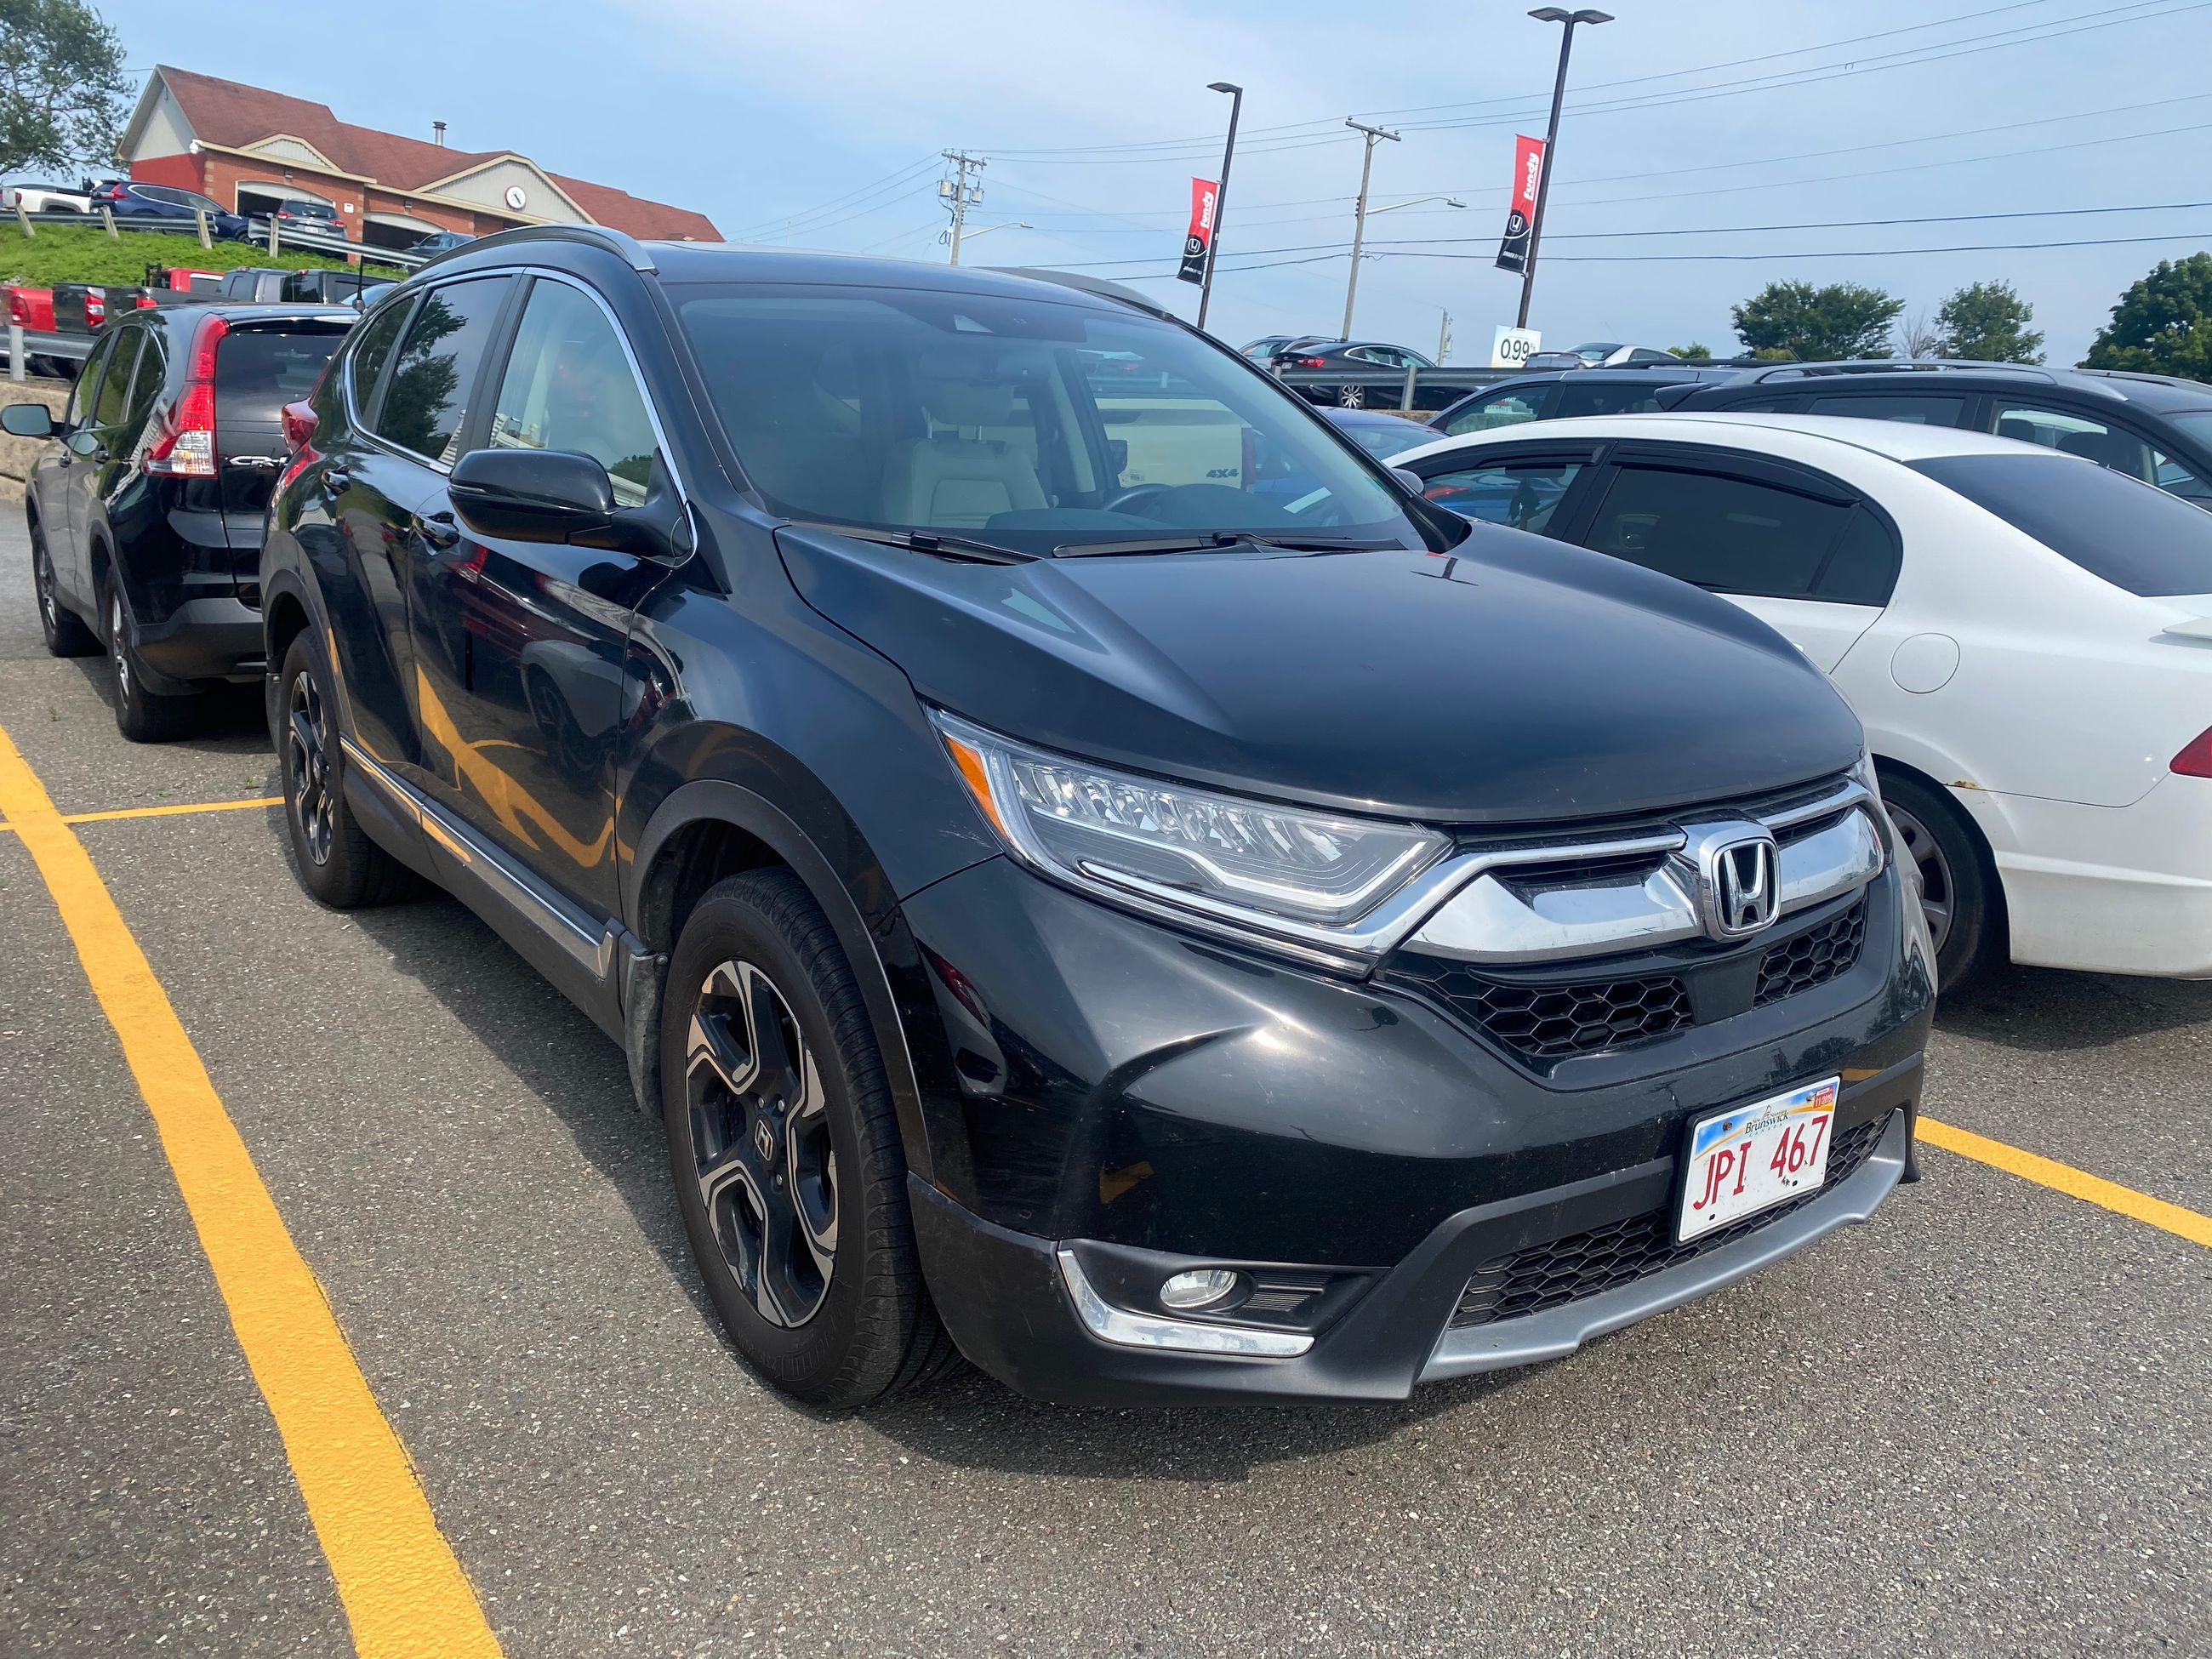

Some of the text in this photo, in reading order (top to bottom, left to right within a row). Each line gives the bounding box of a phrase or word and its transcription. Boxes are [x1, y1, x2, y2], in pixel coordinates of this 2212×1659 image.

[1523, 152, 1539, 201] fundy
[1200, 191, 1214, 229] fundy
[1500, 338, 1530, 362] 0.99
[1206, 469, 1240, 478] 4X4
[1745, 1109, 1788, 1135] Brunswick
[1749, 1123, 1782, 1137] CANADA
[1693, 1115, 1829, 1210] JPI 467
